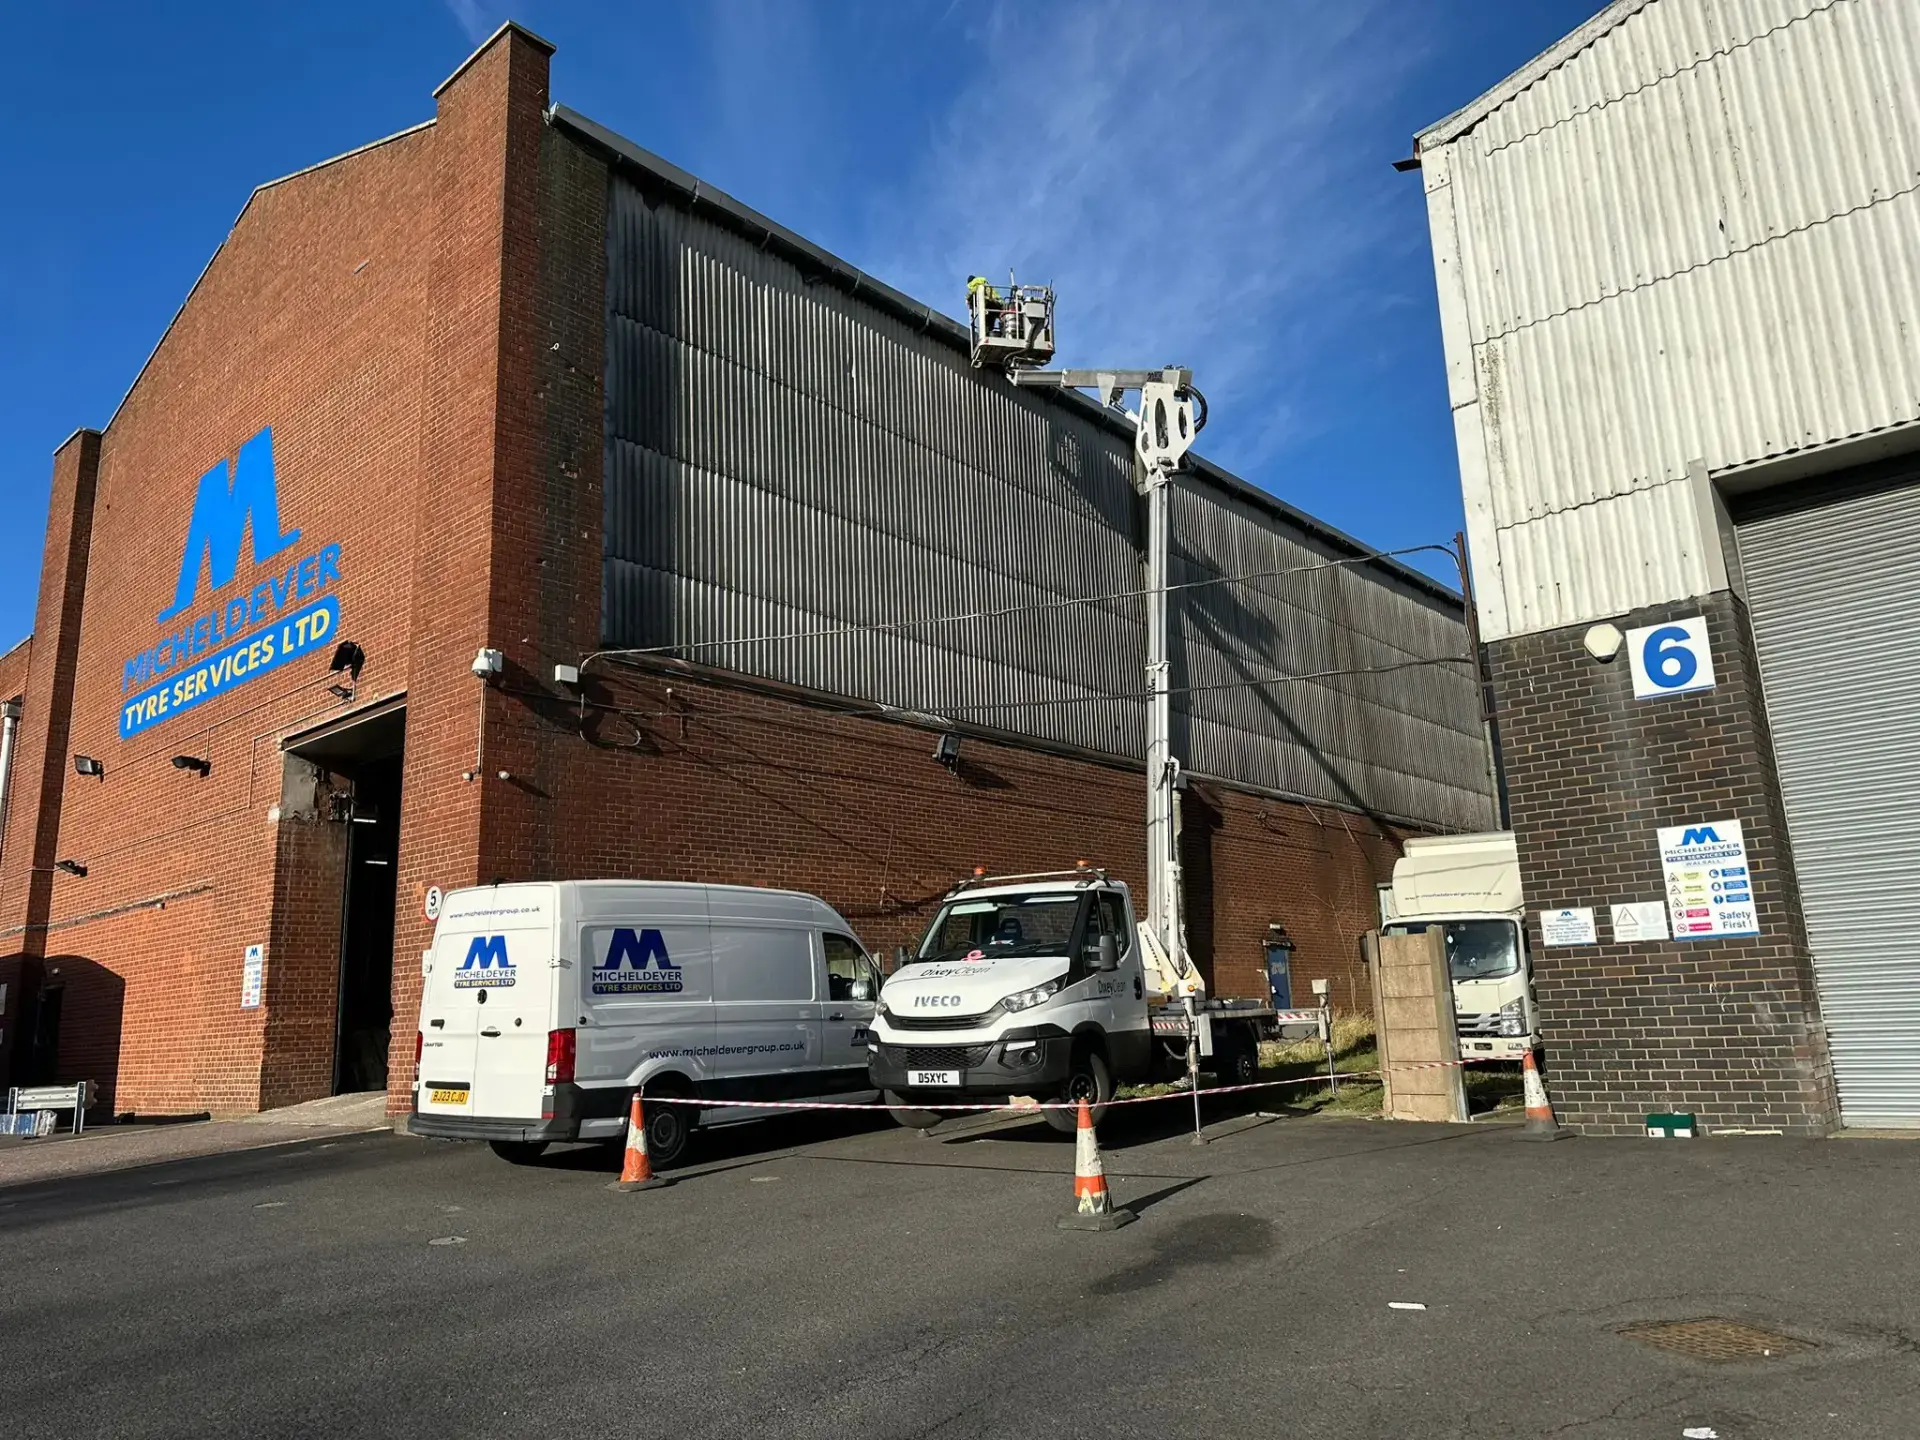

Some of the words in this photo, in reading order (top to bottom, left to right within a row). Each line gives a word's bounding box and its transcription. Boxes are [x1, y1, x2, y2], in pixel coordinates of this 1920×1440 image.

[121, 542, 341, 693] MICHELDEVER
[1643, 626, 1697, 689] 6
[125, 687, 169, 730] TYRE
[172, 634, 275, 707] SERVICES
[281, 608, 330, 654] LTD
[1664, 843, 1740, 856] MICHELDEVER
[1688, 852, 1723, 861] SERVICES
[430, 890, 437, 907] 5
[449, 906, 541, 919] www.micheldevergroup.co.uk
[1719, 910, 1751, 921] Safety
[1723, 920, 1747, 930] First
[454, 969, 517, 979] MICHELDEVER
[592, 971, 682, 982] MICHELDEVER
[595, 984, 619, 992] TYRE
[621, 983, 663, 991] SERVICES
[665, 982, 681, 990] LTD
[914, 995, 961, 1007] IVECO
[649, 1041, 805, 1059] www.micheldevergroup.co.uk
